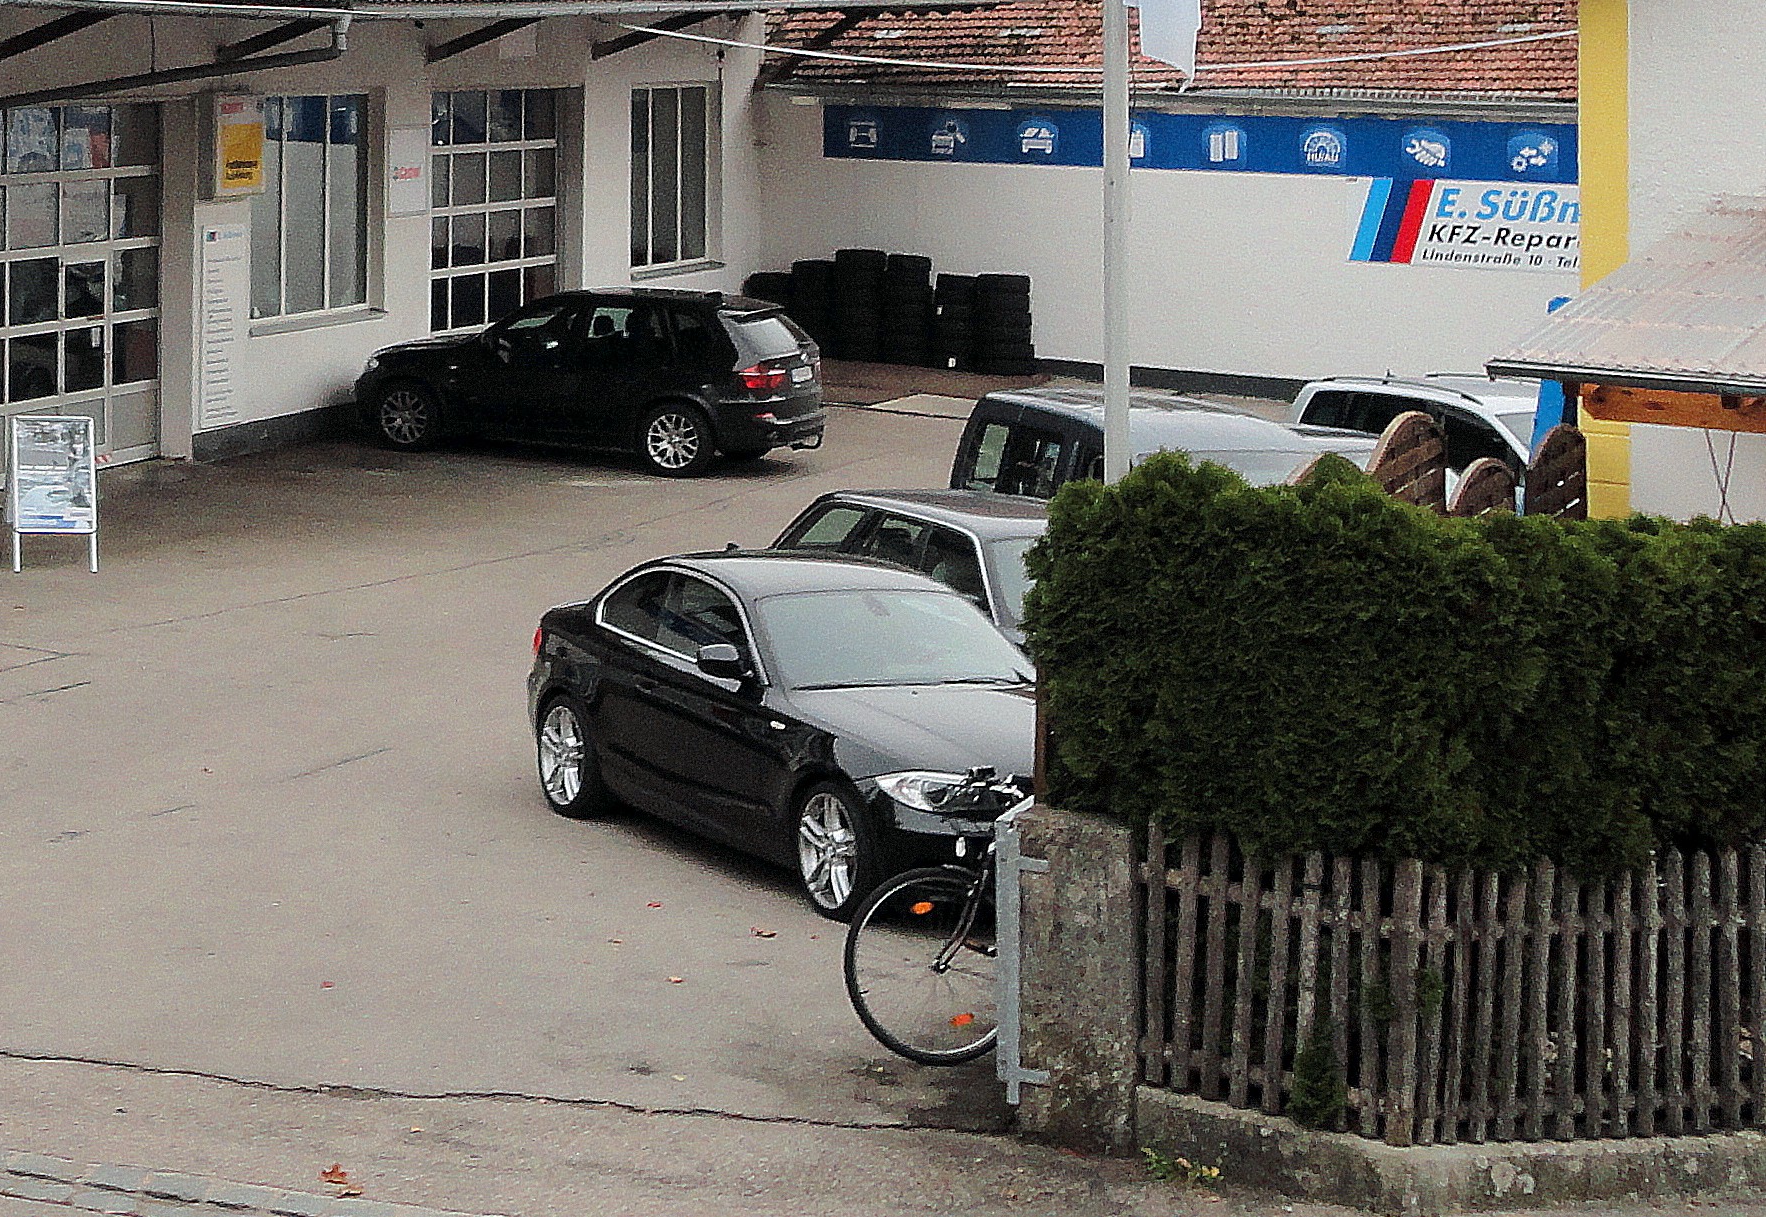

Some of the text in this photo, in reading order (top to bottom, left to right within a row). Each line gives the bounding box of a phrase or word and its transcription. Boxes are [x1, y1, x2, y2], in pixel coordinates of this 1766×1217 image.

[1436, 187, 1469, 219] E.
[1428, 223, 1580, 253] KFZ-Repar
[1422, 247, 1522, 267] Lindenstraße
[1528, 254, 1544, 267] 10
